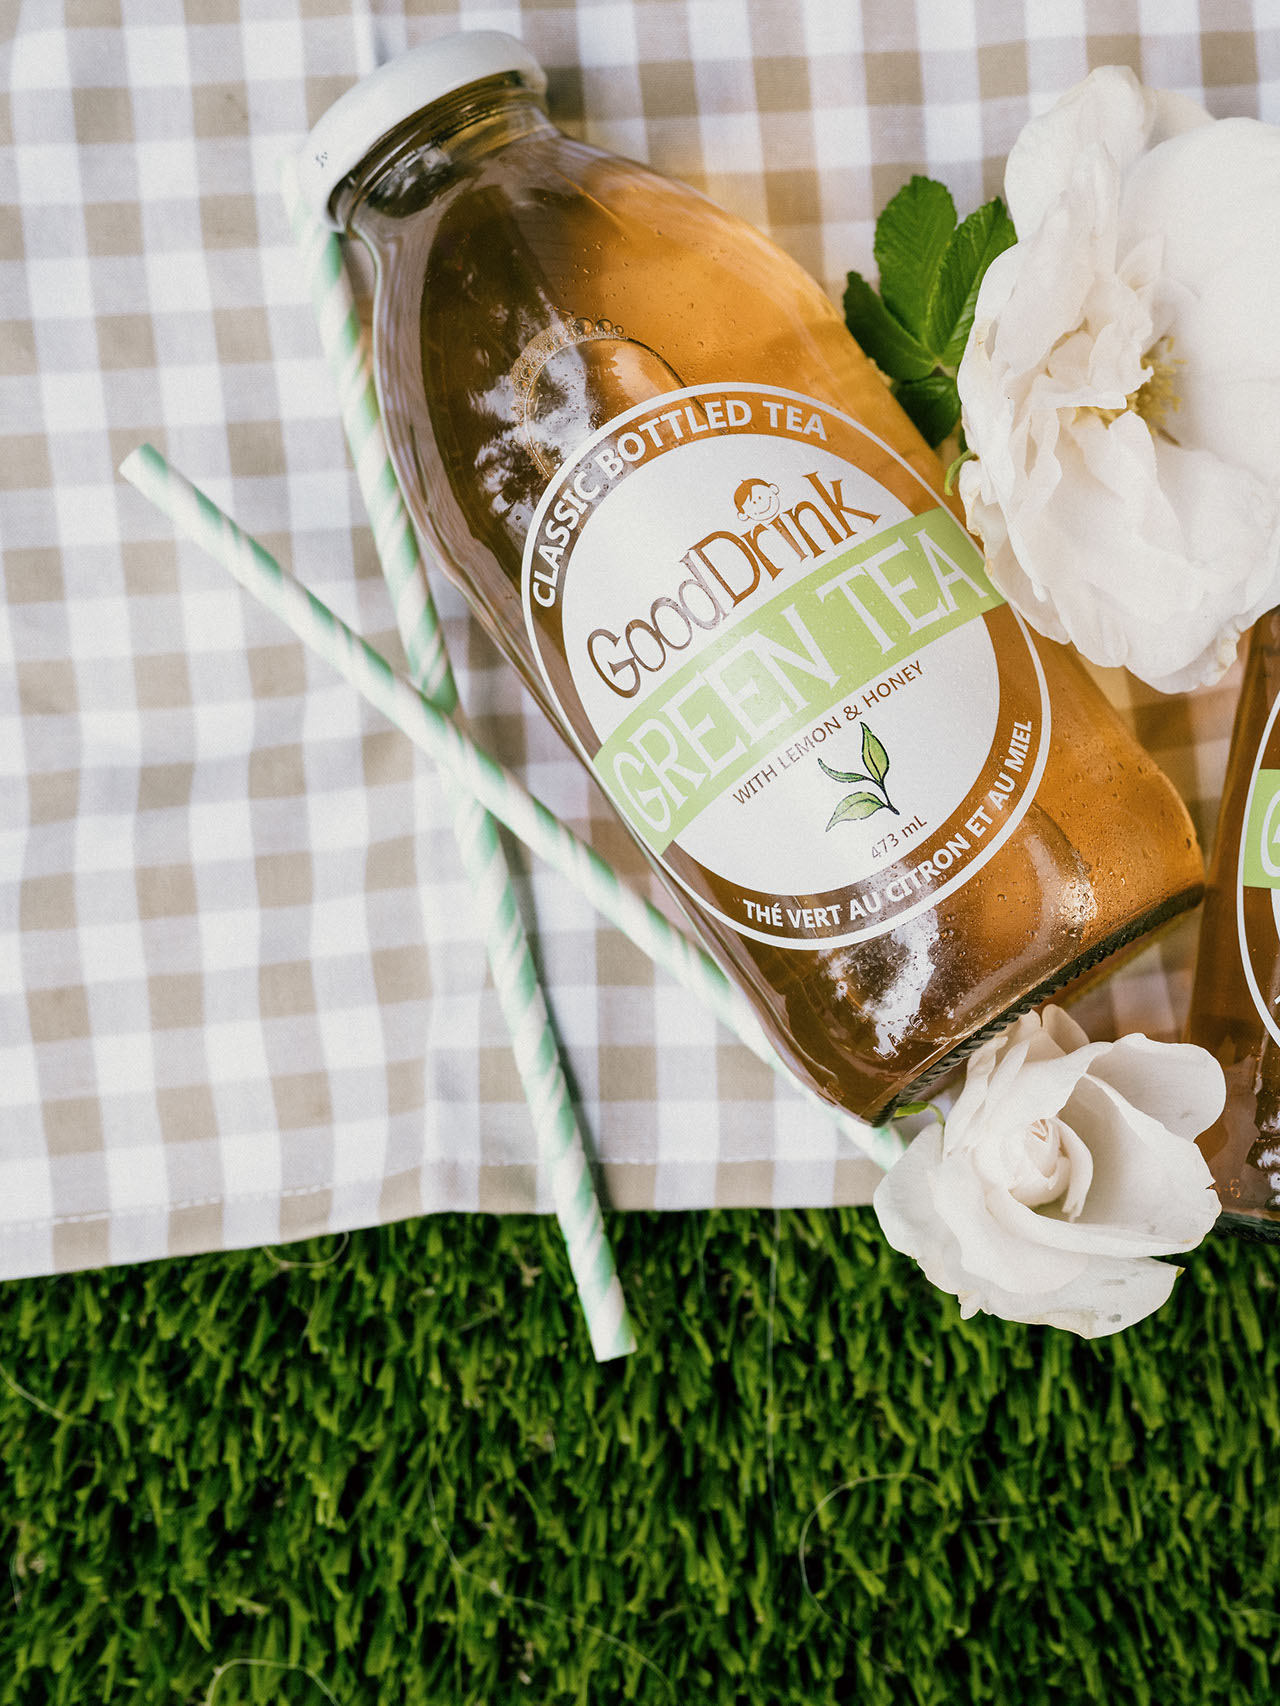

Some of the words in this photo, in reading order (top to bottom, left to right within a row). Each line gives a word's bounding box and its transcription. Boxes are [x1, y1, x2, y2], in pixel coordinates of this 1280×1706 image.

[532, 469, 601, 608] CLASSIC
[594, 399, 753, 481] BOTTLED
[762, 400, 828, 442] TEA
[587, 470, 881, 699] GoodDrink
[612, 605, 843, 833] GREEN
[815, 527, 989, 652] TEA
[732, 763, 778, 805] WITH
[777, 716, 843, 770] LEMON
[842, 704, 863, 722] &
[861, 660, 925, 709] HONEY
[742, 898, 784, 928] THÉ
[786, 904, 843, 930] VERT
[849, 891, 883, 921] AU
[885, 832, 972, 903] CITRON
[964, 804, 995, 838] ET
[987, 771, 1016, 810] AU
[1004, 719, 1033, 774] MIEL
[870, 833, 900, 860] 473
[901, 815, 928, 839] mL
